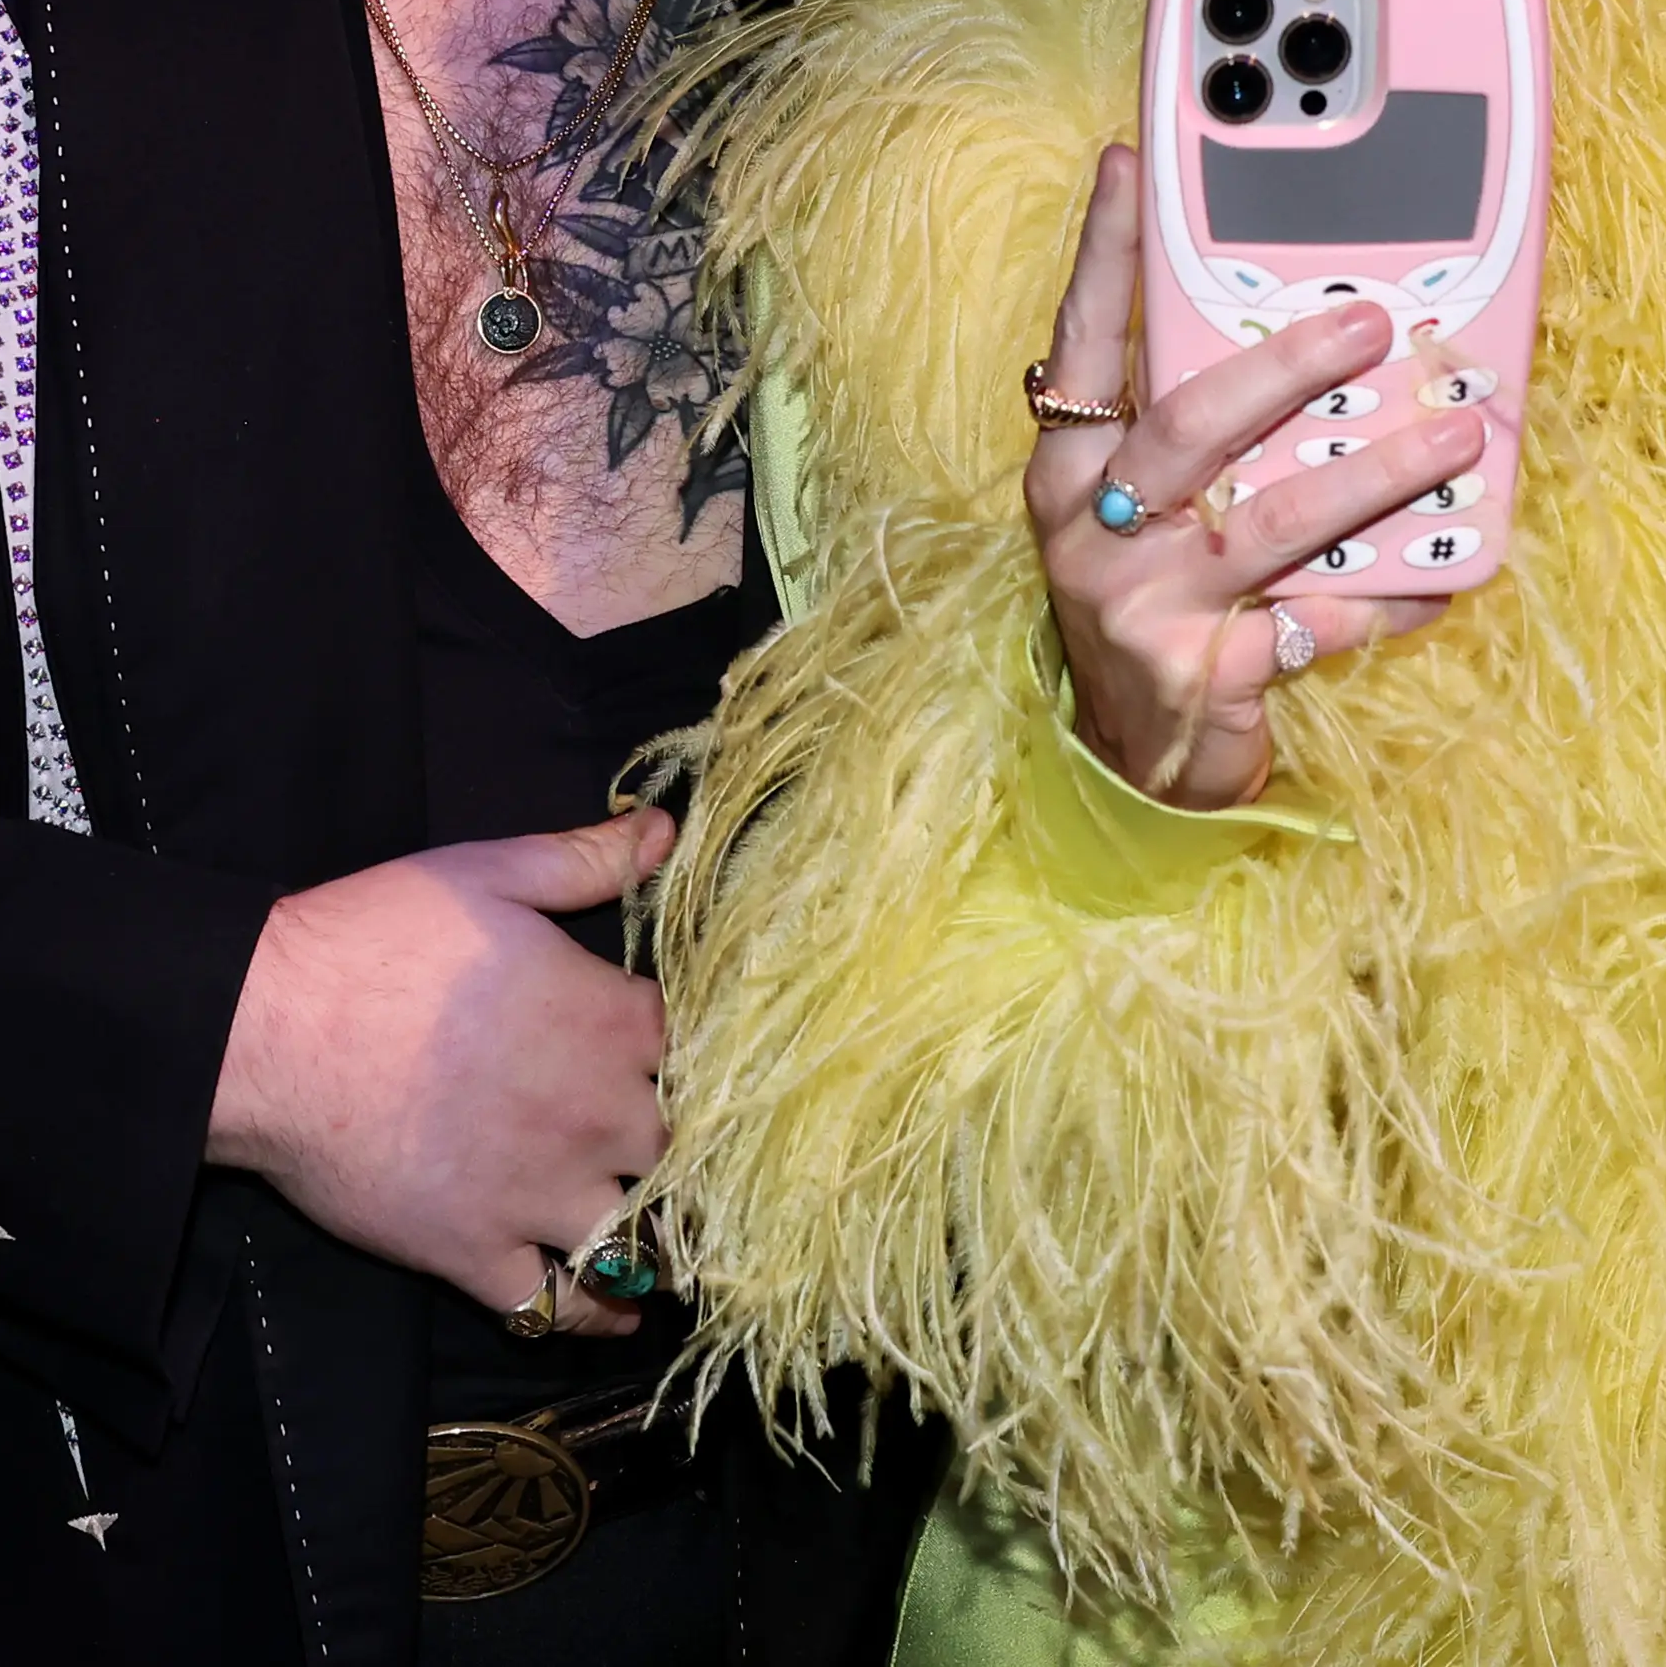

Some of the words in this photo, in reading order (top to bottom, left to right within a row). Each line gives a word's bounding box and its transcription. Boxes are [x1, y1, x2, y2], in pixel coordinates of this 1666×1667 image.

[1448, 379, 1468, 402] 3
[1329, 393, 1348, 414] 2
[1435, 481, 1454, 508] 9
[1430, 536, 1455, 561] #
